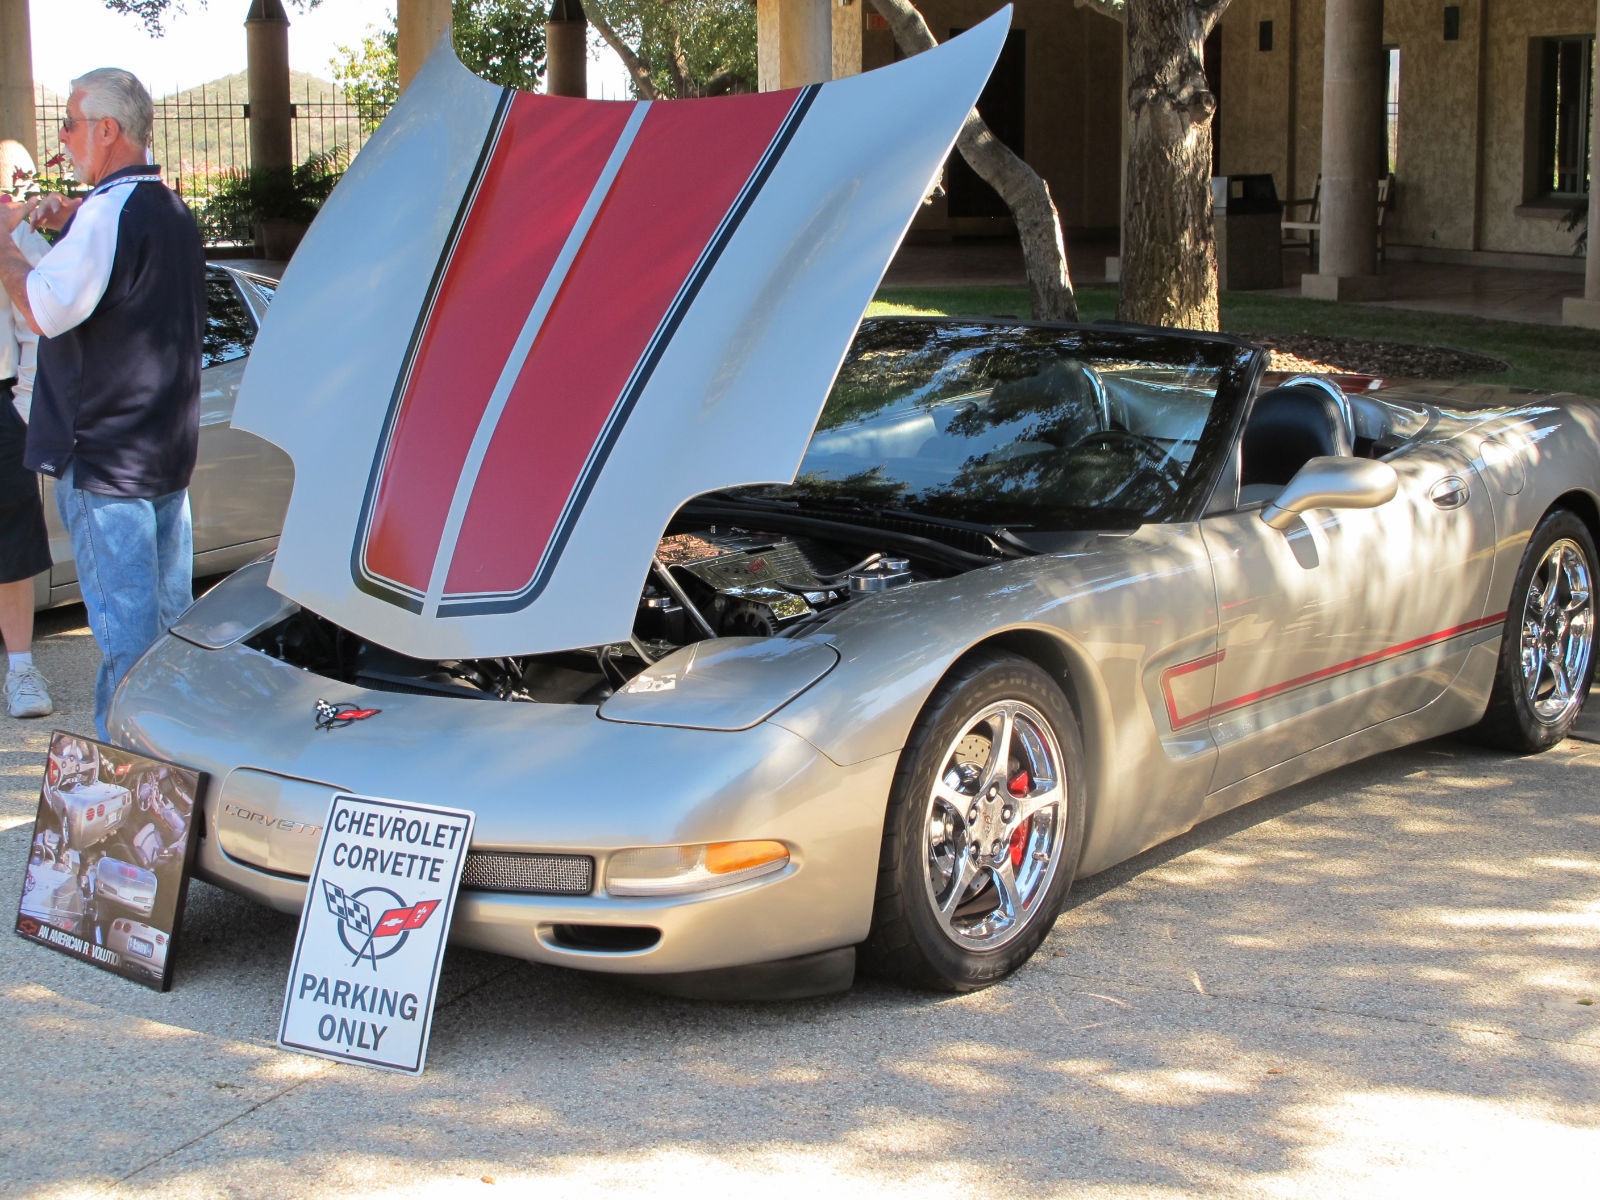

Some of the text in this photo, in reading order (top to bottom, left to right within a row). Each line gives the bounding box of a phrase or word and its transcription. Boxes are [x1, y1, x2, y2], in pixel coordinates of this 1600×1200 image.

[225, 804, 324, 835] CORVETT
[334, 808, 461, 850] CHEVROLET
[333, 843, 444, 882] CORVETTE
[38, 925, 49, 939] AN
[49, 929, 83, 952] AMERICAN
[299, 973, 418, 1021] PARKING
[318, 1014, 388, 1051] ONLY
